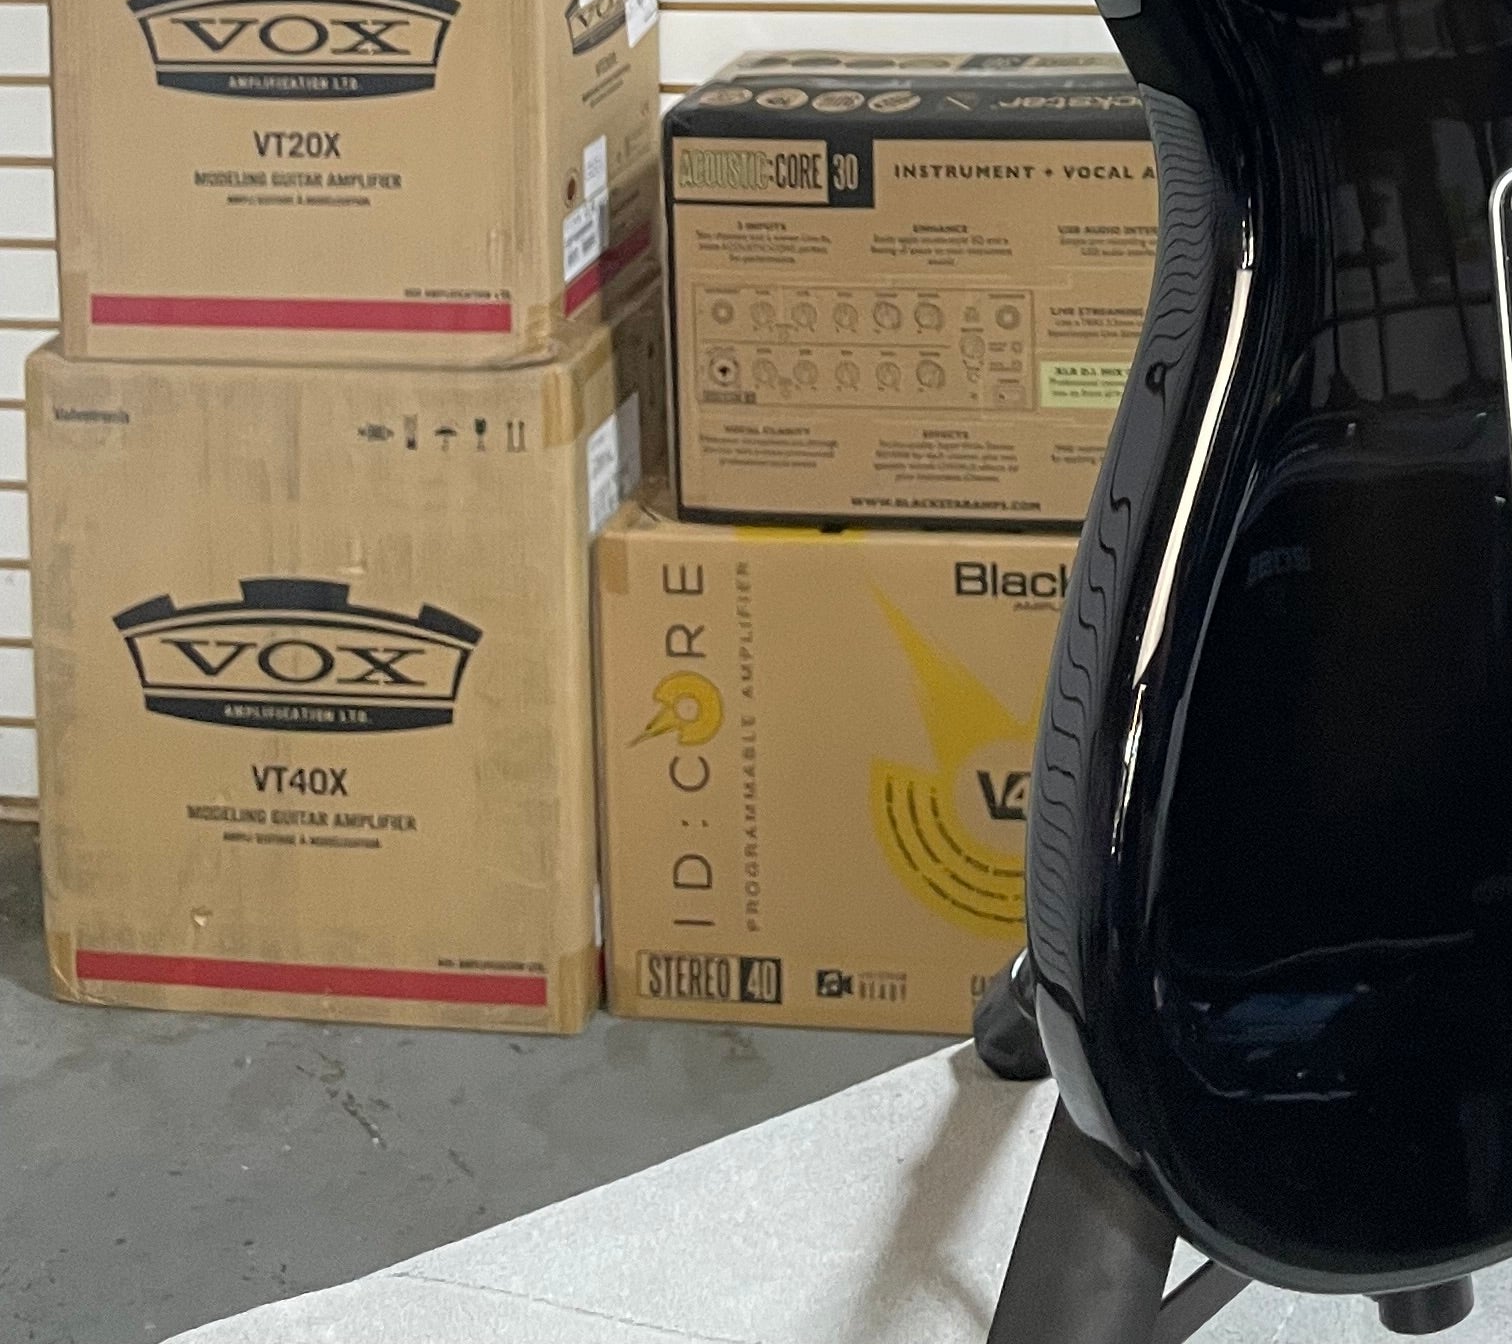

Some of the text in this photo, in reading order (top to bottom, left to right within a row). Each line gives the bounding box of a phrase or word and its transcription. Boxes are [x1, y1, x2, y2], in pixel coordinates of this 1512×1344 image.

[169, 15, 411, 57] VOX
[252, 129, 342, 159] VT20X
[326, 171, 403, 189] AMPLIFIER
[832, 152, 860, 191] 30
[893, 162, 1035, 180] INSTRUMENT
[1063, 164, 1132, 180] VOCAL
[163, 639, 426, 686] VOX
[735, 561, 762, 933] PROGRAMMABLE AMPLIFIER
[251, 764, 348, 797] VT40X
[333, 812, 418, 831] AMPLIFIER
[648, 956, 777, 1000] STEREO 40
